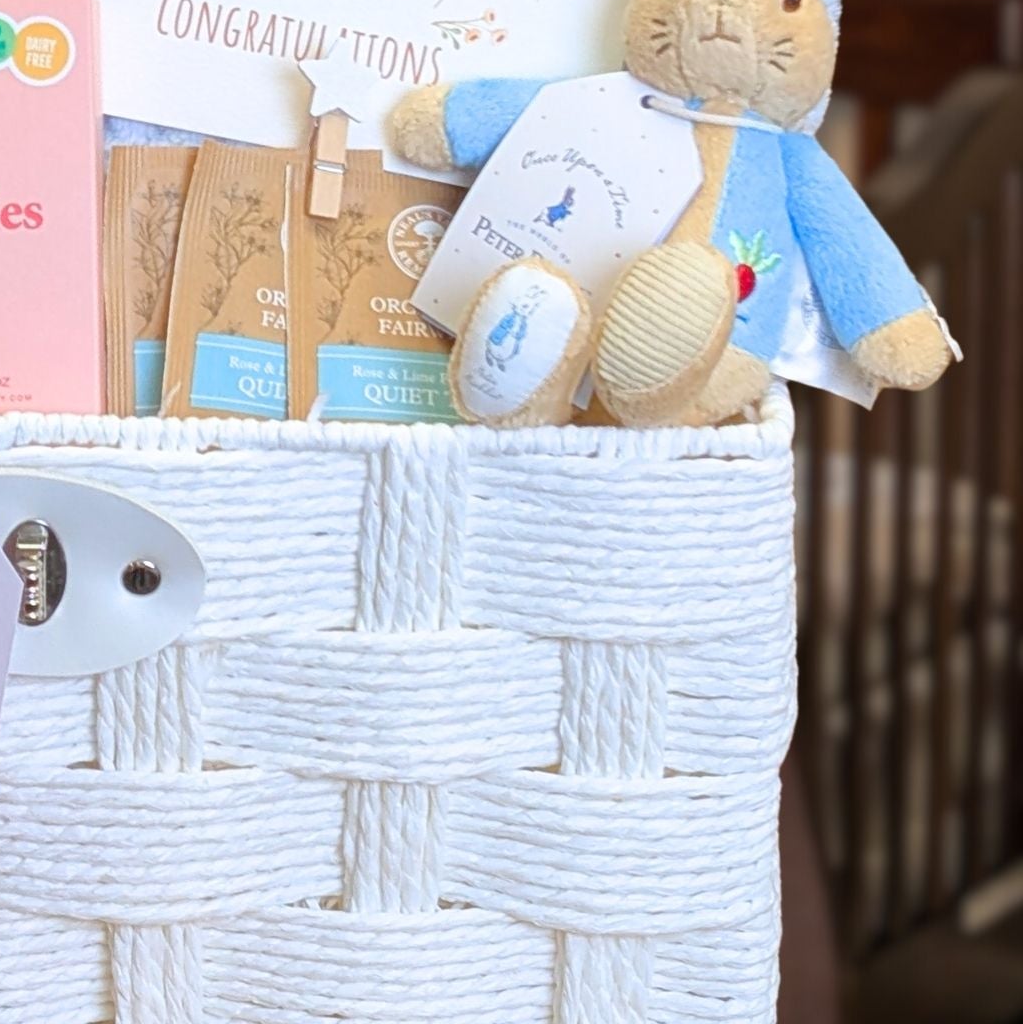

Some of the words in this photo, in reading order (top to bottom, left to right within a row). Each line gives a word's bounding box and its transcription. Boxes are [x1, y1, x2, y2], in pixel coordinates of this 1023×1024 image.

[25, 36, 57, 53] DAIRY
[25, 52, 52, 69] FREE
[521, 150, 558, 169] Once
[562, 148, 604, 177] Upon
[608, 186, 630, 229] Time
[229, 356, 261, 373] Rose
[263, 361, 276, 374] &
[353, 365, 384, 380] Rose
[387, 368, 399, 380] &
[402, 369, 435, 384] Lime
[364, 383, 439, 406] QUIET
